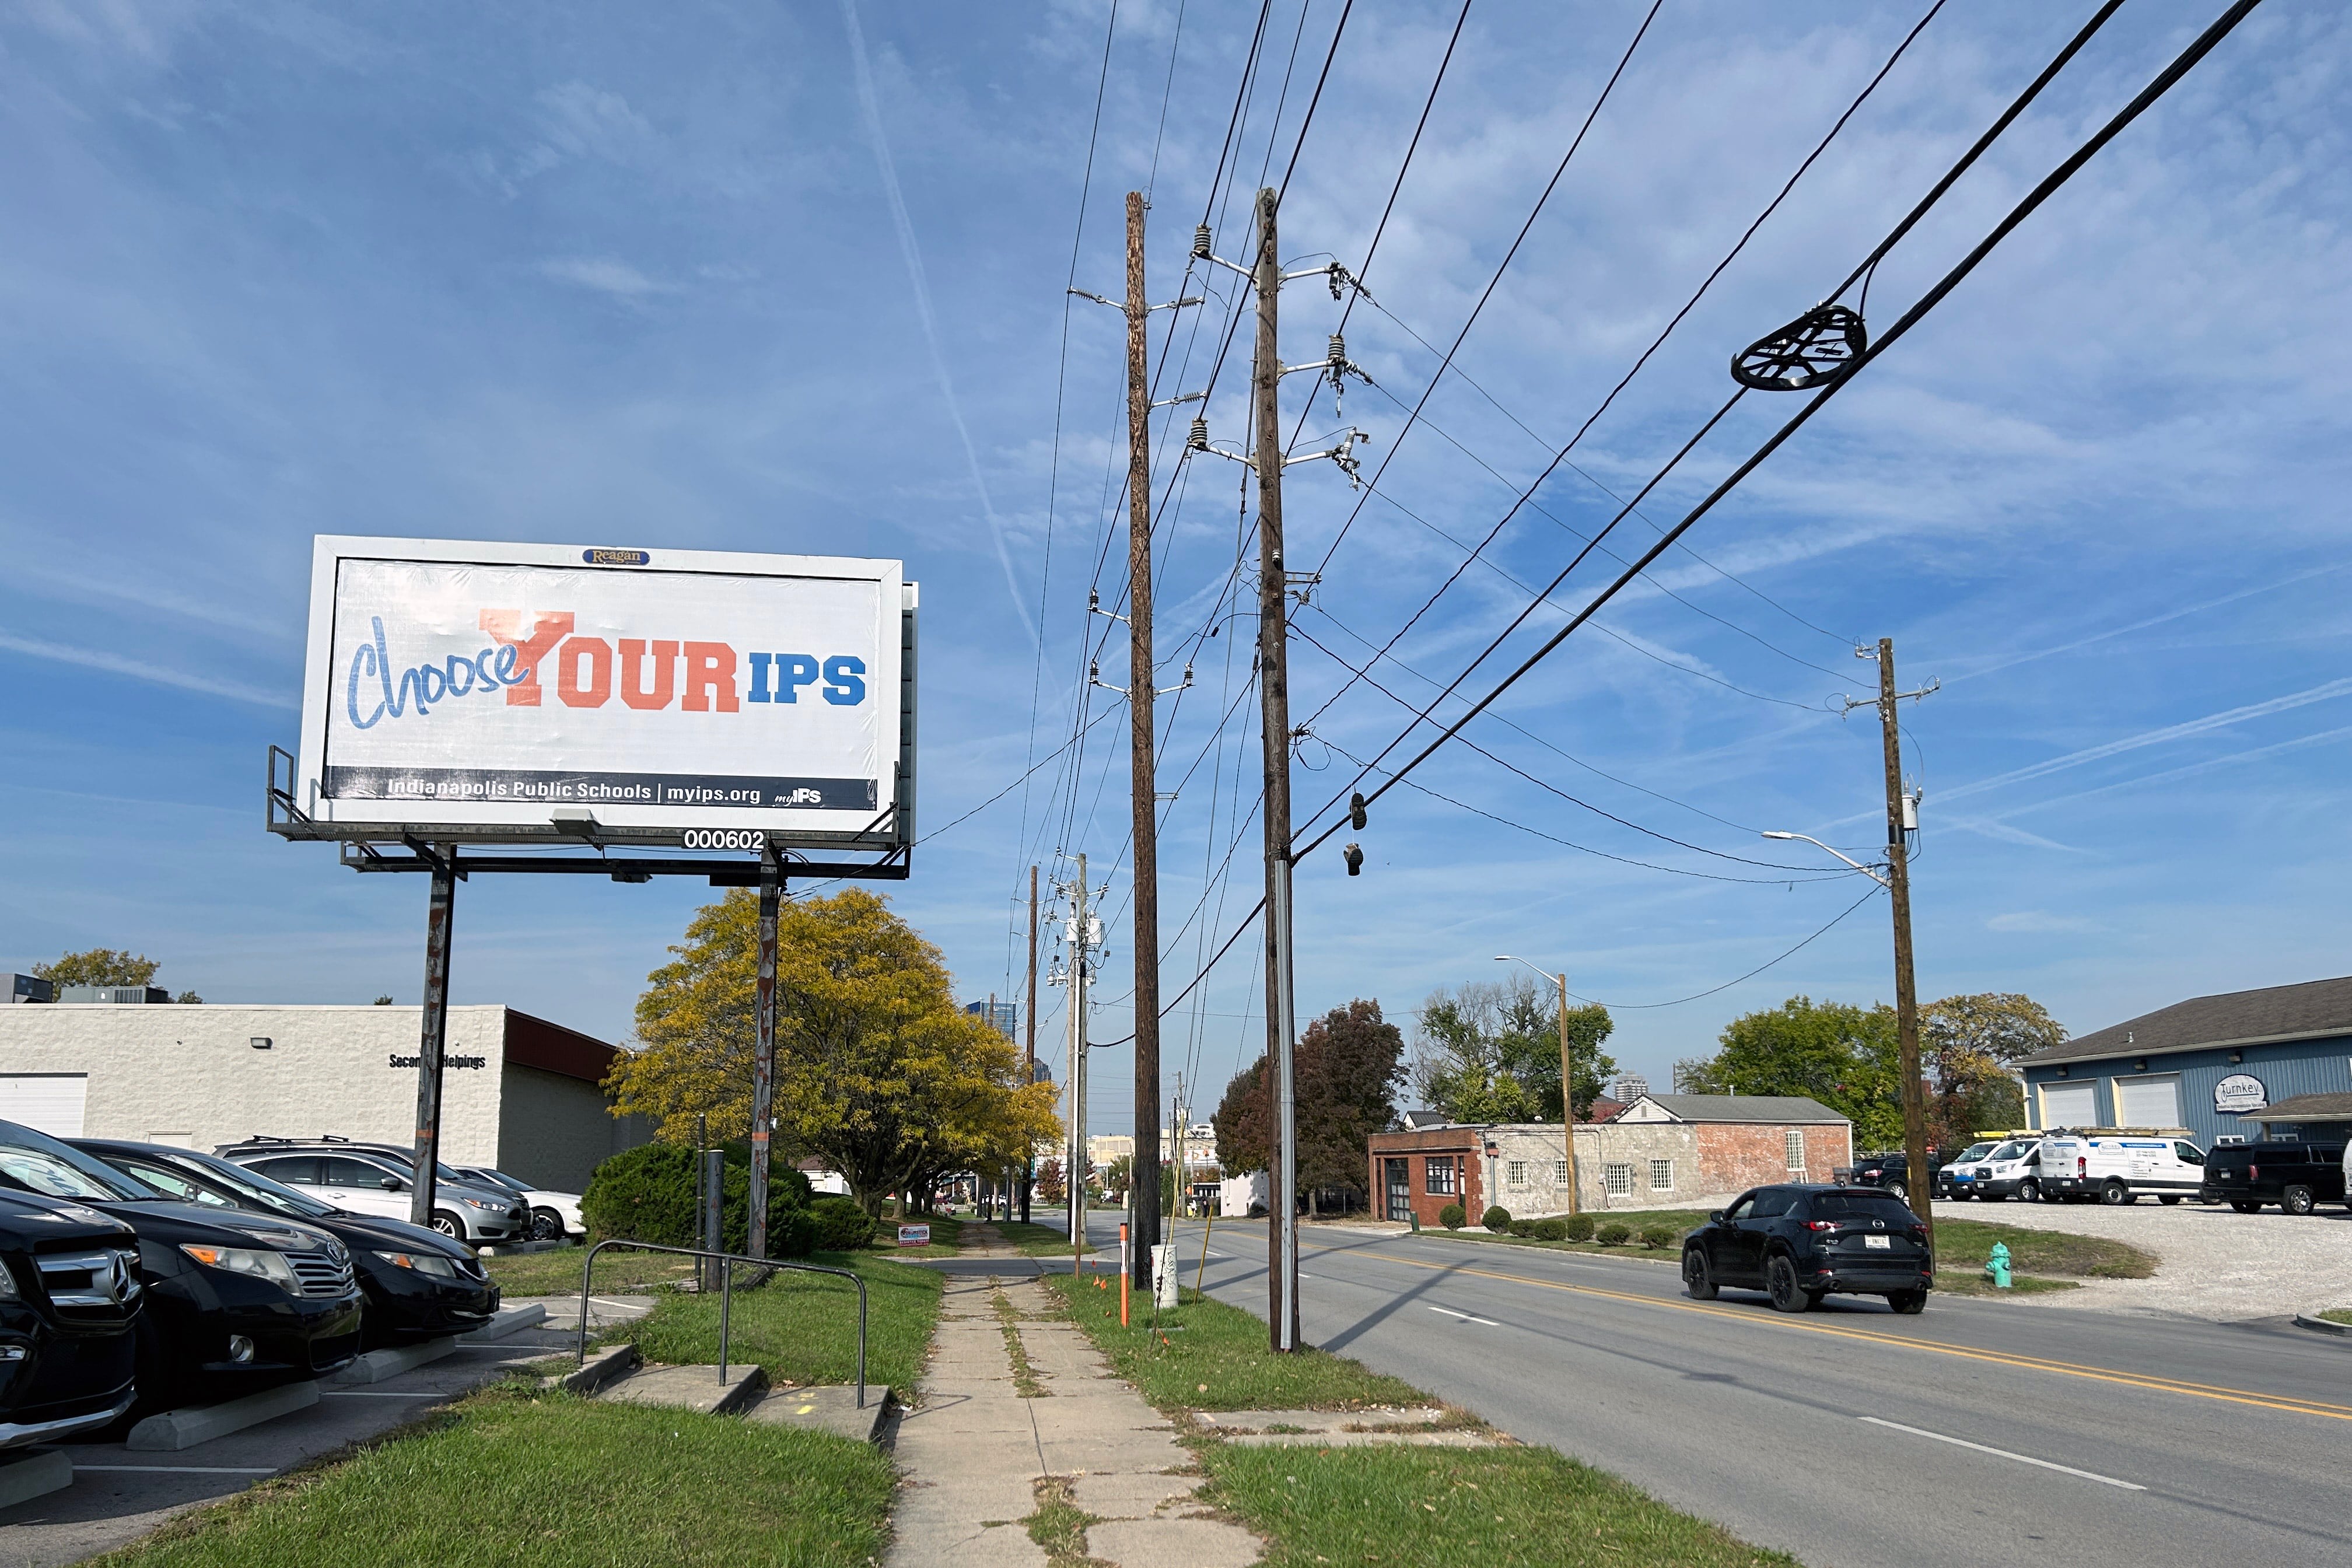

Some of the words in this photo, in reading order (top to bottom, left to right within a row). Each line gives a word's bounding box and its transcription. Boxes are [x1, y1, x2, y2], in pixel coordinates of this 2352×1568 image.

[592, 550, 641, 564] Reagan
[347, 615, 530, 730] Choose
[479, 608, 740, 713] YOUR
[748, 652, 866, 706] IPS
[388, 778, 508, 797] Indianapolis
[513, 781, 572, 797] Public
[576, 782, 652, 800] Schools
[667, 785, 761, 804] myips.org
[774, 788, 822, 807] myIPS
[684, 830, 764, 850] 000602
[389, 1054, 421, 1068] Secon
[443, 1054, 486, 1070] Helpings
[2220, 1082, 2259, 1099] Turnkey
